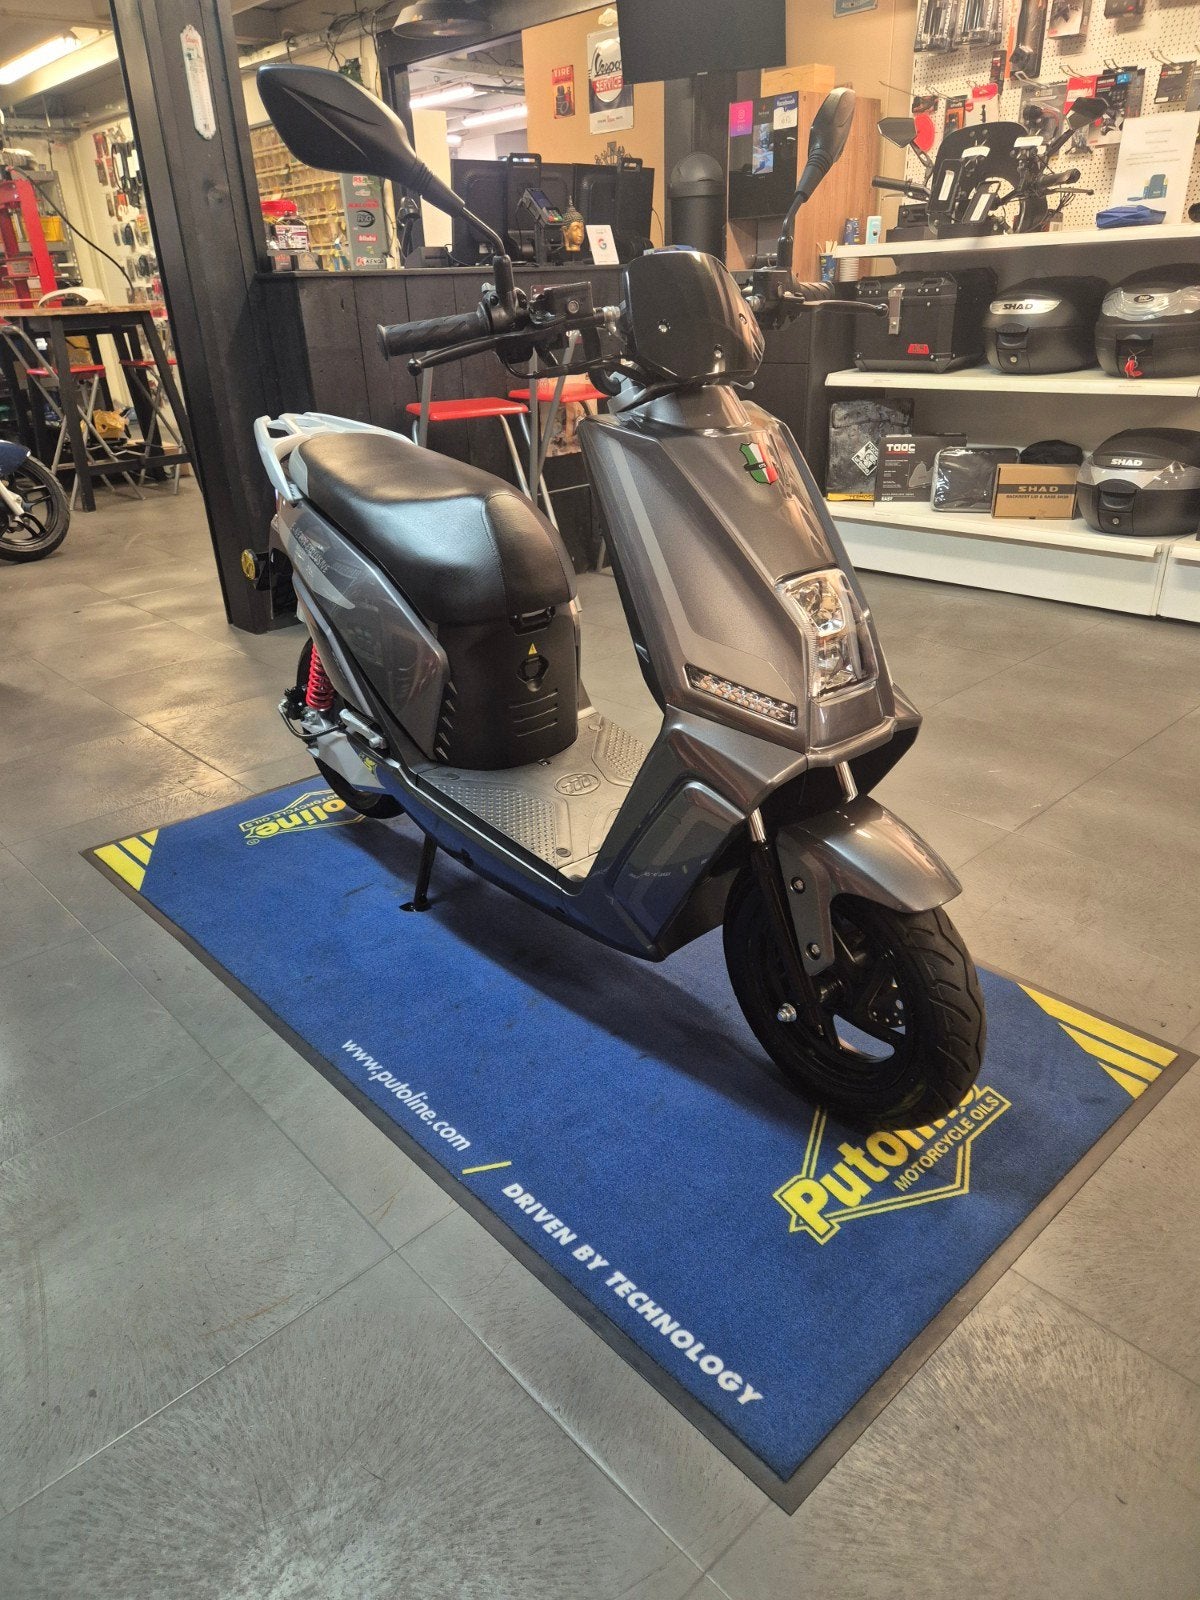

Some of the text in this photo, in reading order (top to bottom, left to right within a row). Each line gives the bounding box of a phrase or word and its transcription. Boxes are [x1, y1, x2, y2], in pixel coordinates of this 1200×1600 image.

[553, 67, 570, 77] TIRE
[1111, 458, 1143, 467] SHAD
[246, 817, 270, 828] OILS
[255, 799, 346, 836] oline
[341, 1039, 471, 1151] www.putoline.com
[783, 1088, 975, 1234] Puto
[893, 1096, 1000, 1192] MOTORCYCLE OILS
[502, 1182, 763, 1406] DRIVEN BY TECHNOLOGY
